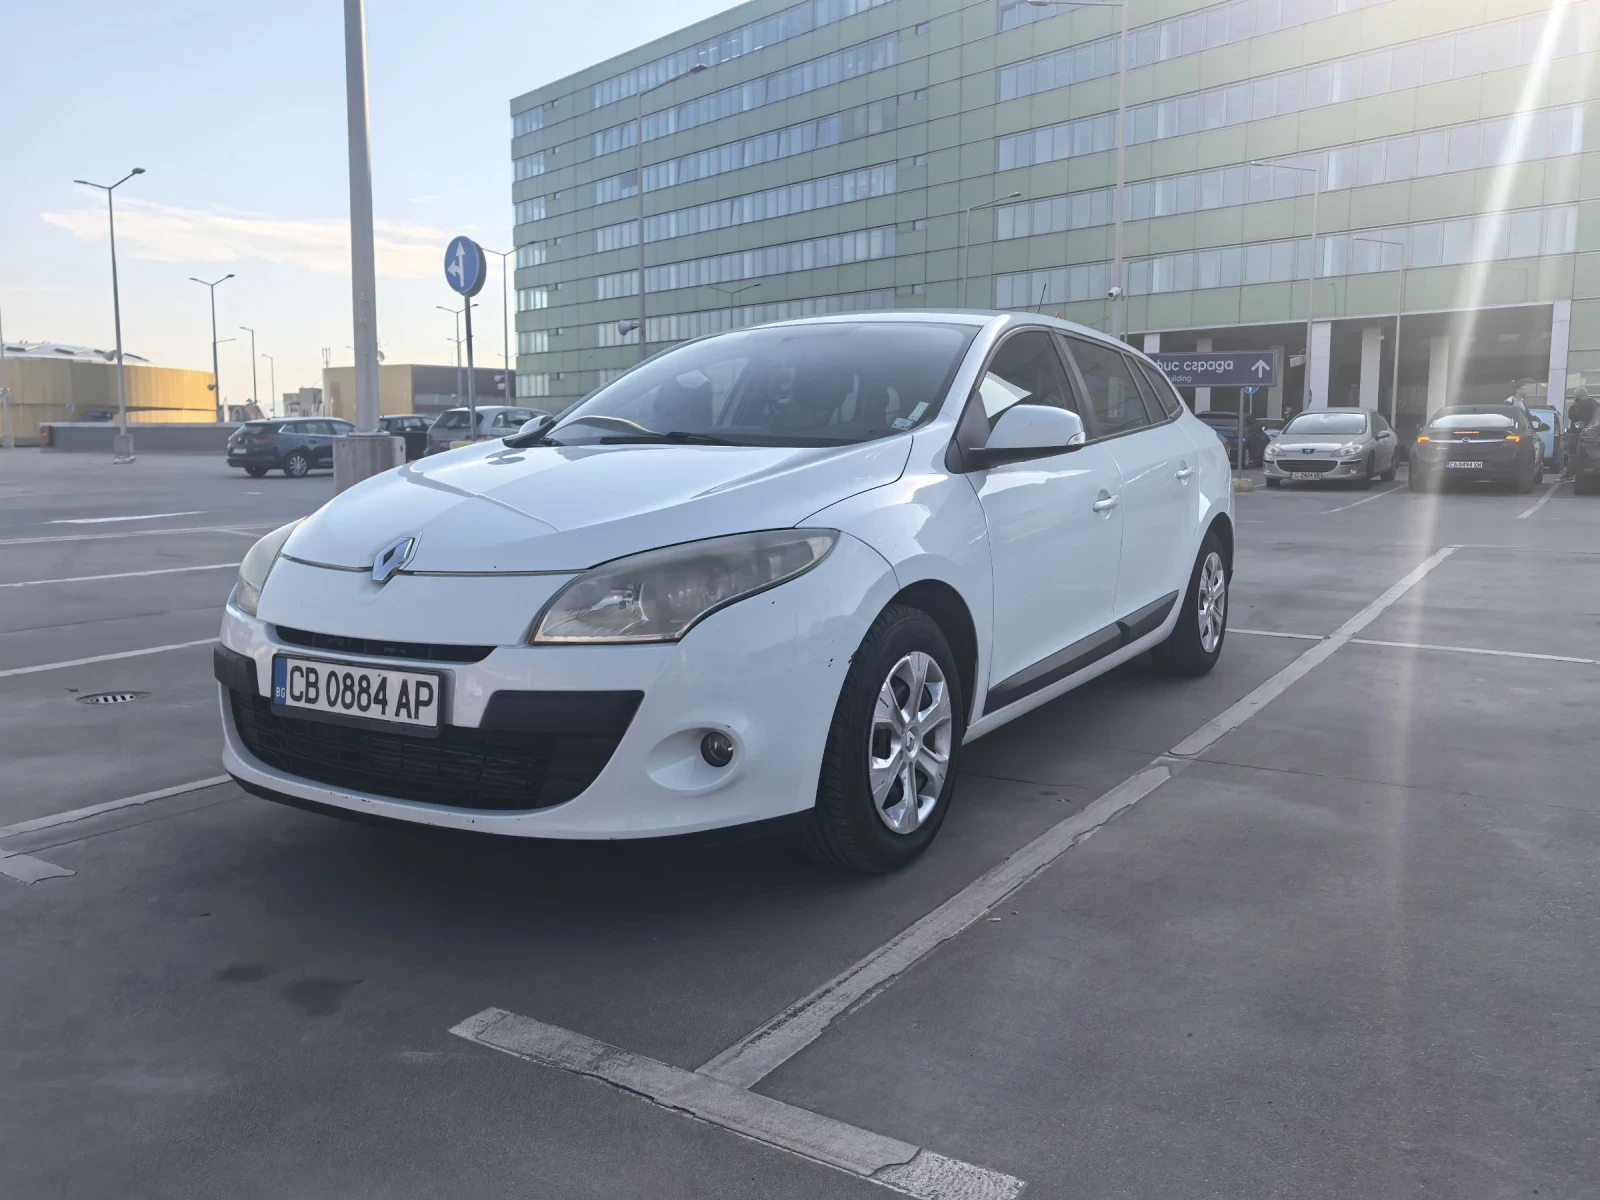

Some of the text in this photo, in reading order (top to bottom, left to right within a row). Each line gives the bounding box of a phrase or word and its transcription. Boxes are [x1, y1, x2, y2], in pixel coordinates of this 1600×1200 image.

[1156, 359, 1234, 373] фис сграда
[1168, 375, 1192, 383] uilding
[275, 665, 434, 720] BG CB 0884 AP
